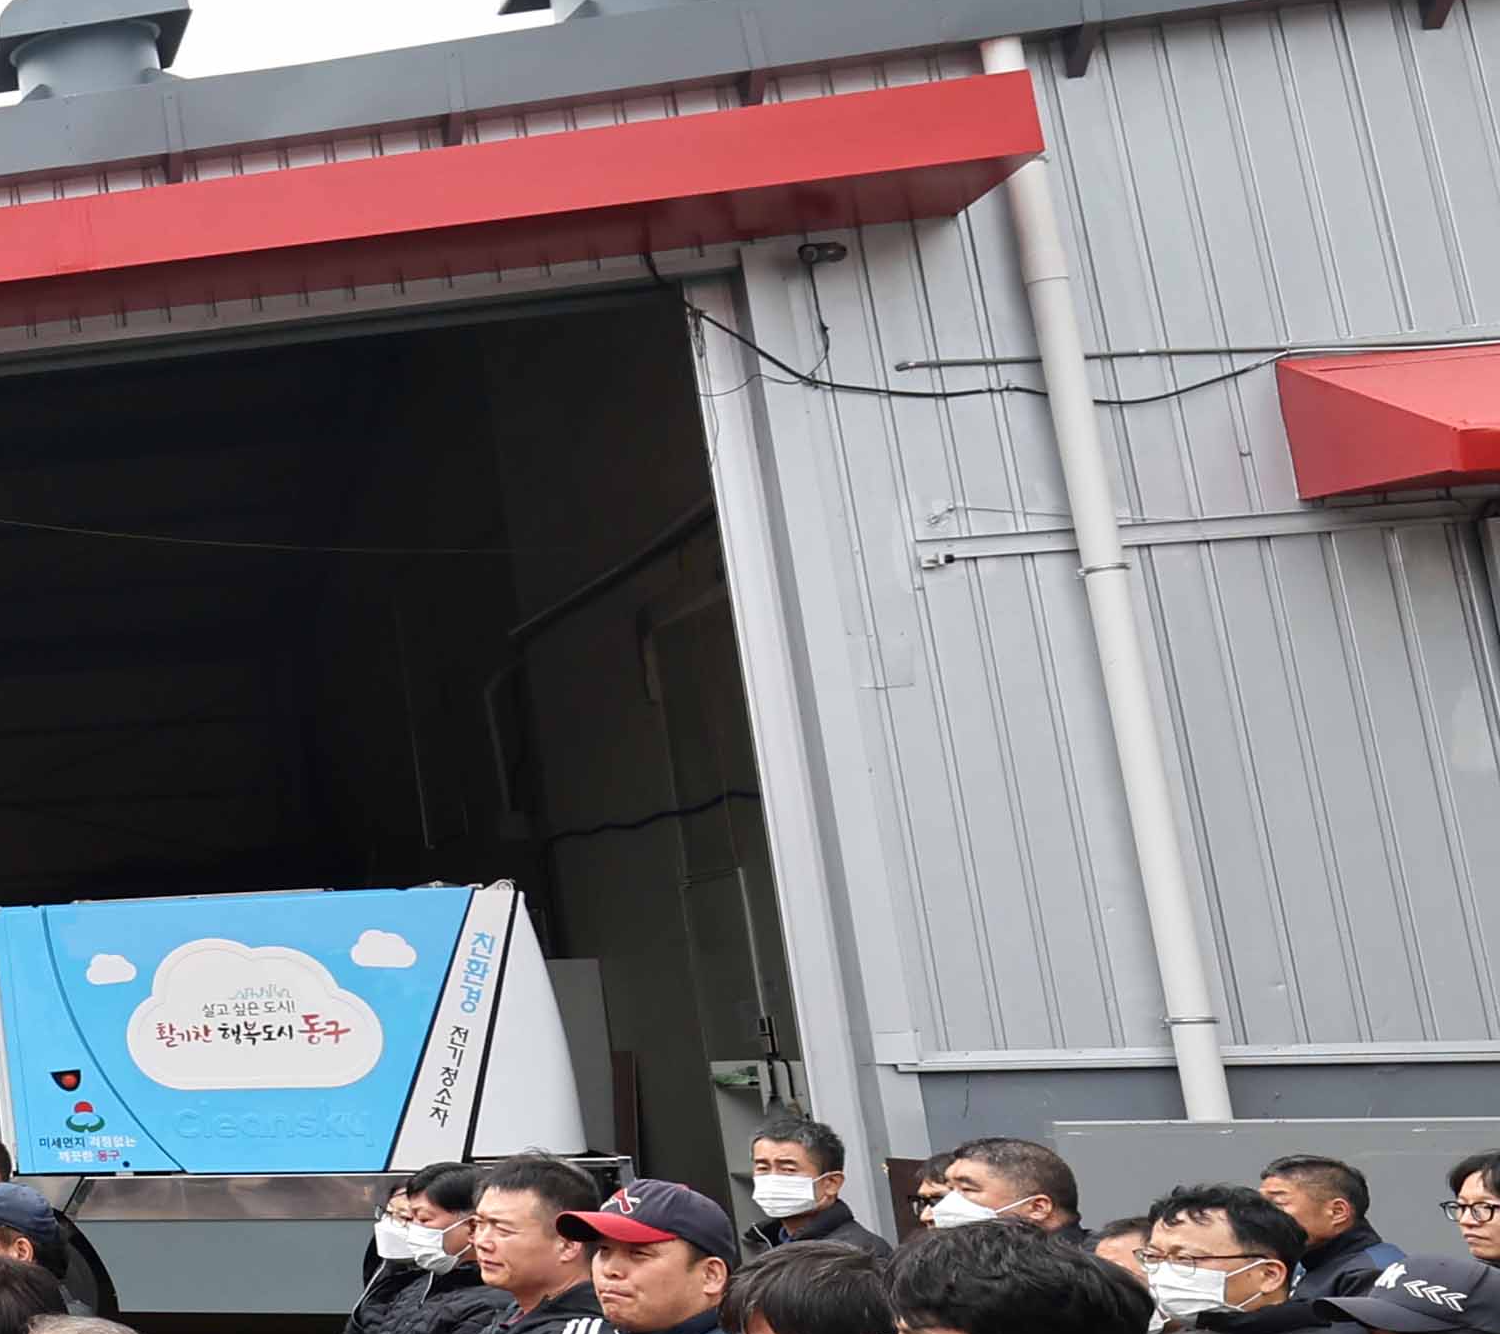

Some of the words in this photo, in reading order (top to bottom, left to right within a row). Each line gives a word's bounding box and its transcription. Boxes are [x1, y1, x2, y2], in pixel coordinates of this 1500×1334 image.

[460, 931, 496, 1013] 친환경
[202, 1002, 229, 1017] 살고
[233, 1001, 259, 1016] 싶은
[264, 1000, 296, 1014] 도시!
[156, 1021, 213, 1048] 활기찬
[217, 1020, 294, 1046] 행복도시
[298, 1014, 351, 1045] 동구
